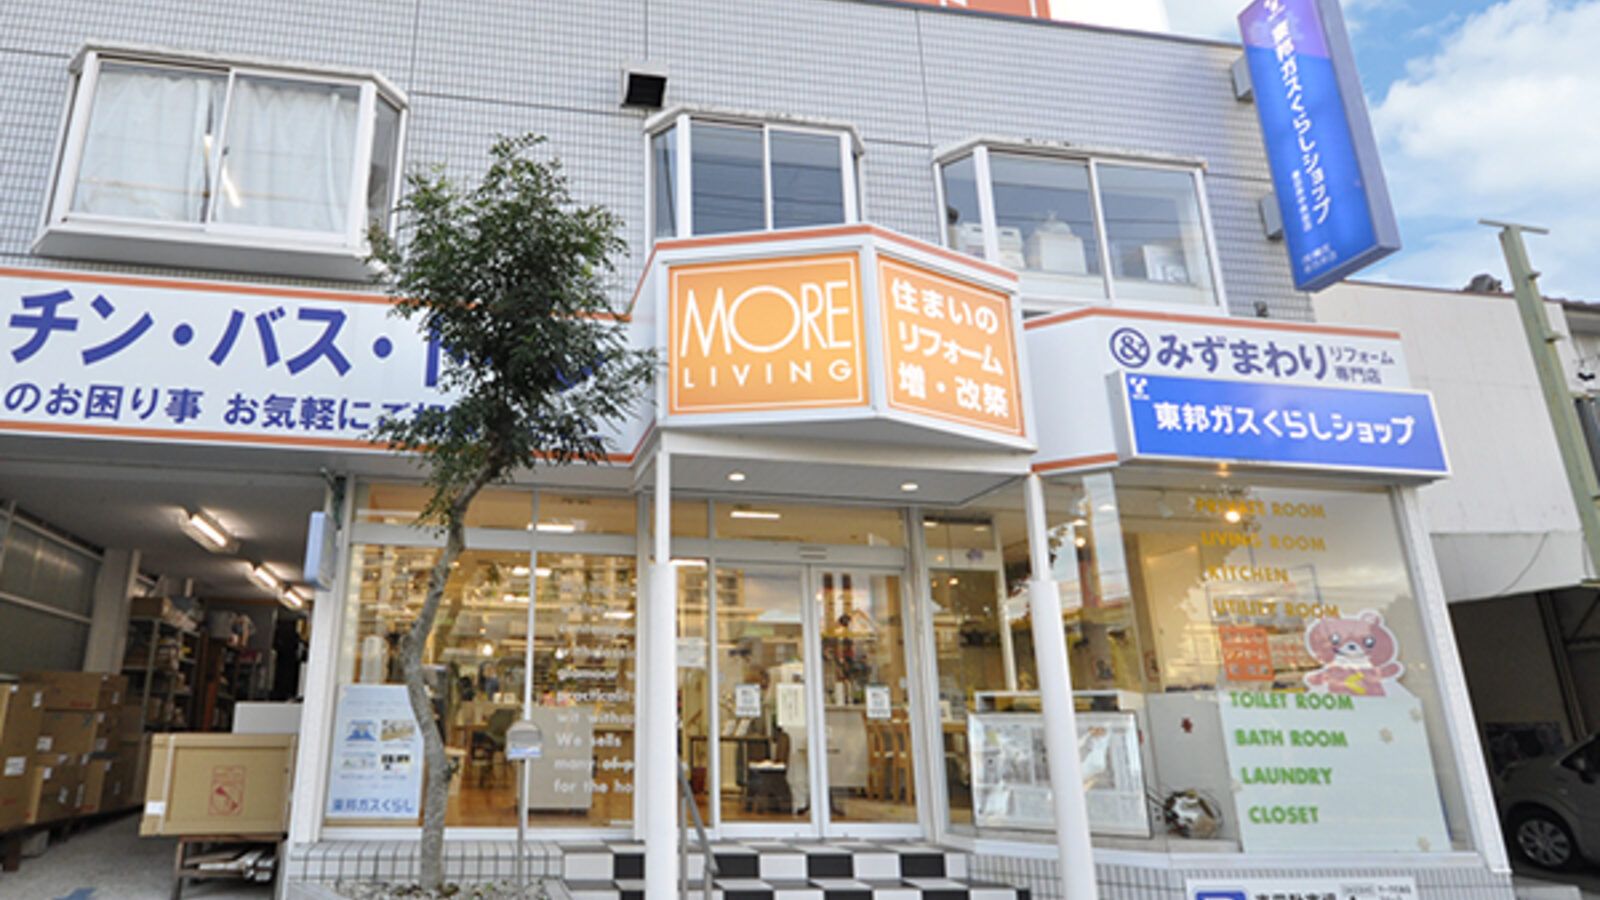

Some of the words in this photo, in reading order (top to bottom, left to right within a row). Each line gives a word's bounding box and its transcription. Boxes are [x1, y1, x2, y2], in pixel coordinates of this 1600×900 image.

[891, 277, 998, 334] 住まいの
[680, 281, 852, 358] MORE
[898, 320, 1004, 376] リフォーム
[1156, 334, 1328, 380] みずまわり
[684, 359, 853, 389] LIVING
[897, 362, 1009, 418] 増・改築
[4, 382, 204, 424] のお困り事
[1153, 401, 1415, 445] 東邦ガスくらしショップ
[1196, 499, 1266, 516] PRIVATE
[1272, 502, 1326, 518] ROOM
[1201, 530, 1262, 548] LIVING
[1269, 534, 1326, 551] ROOM
[1206, 565, 1289, 583] KITCHEN
[1284, 601, 1340, 618] ROOM
[1229, 691, 1287, 709] TOILET
[1296, 692, 1354, 710] ROOM
[1235, 729, 1284, 747] BATH
[1290, 730, 1347, 748] ROOM
[1242, 766, 1332, 785] LAUNDRY
[1248, 806, 1319, 824] CLOSET
